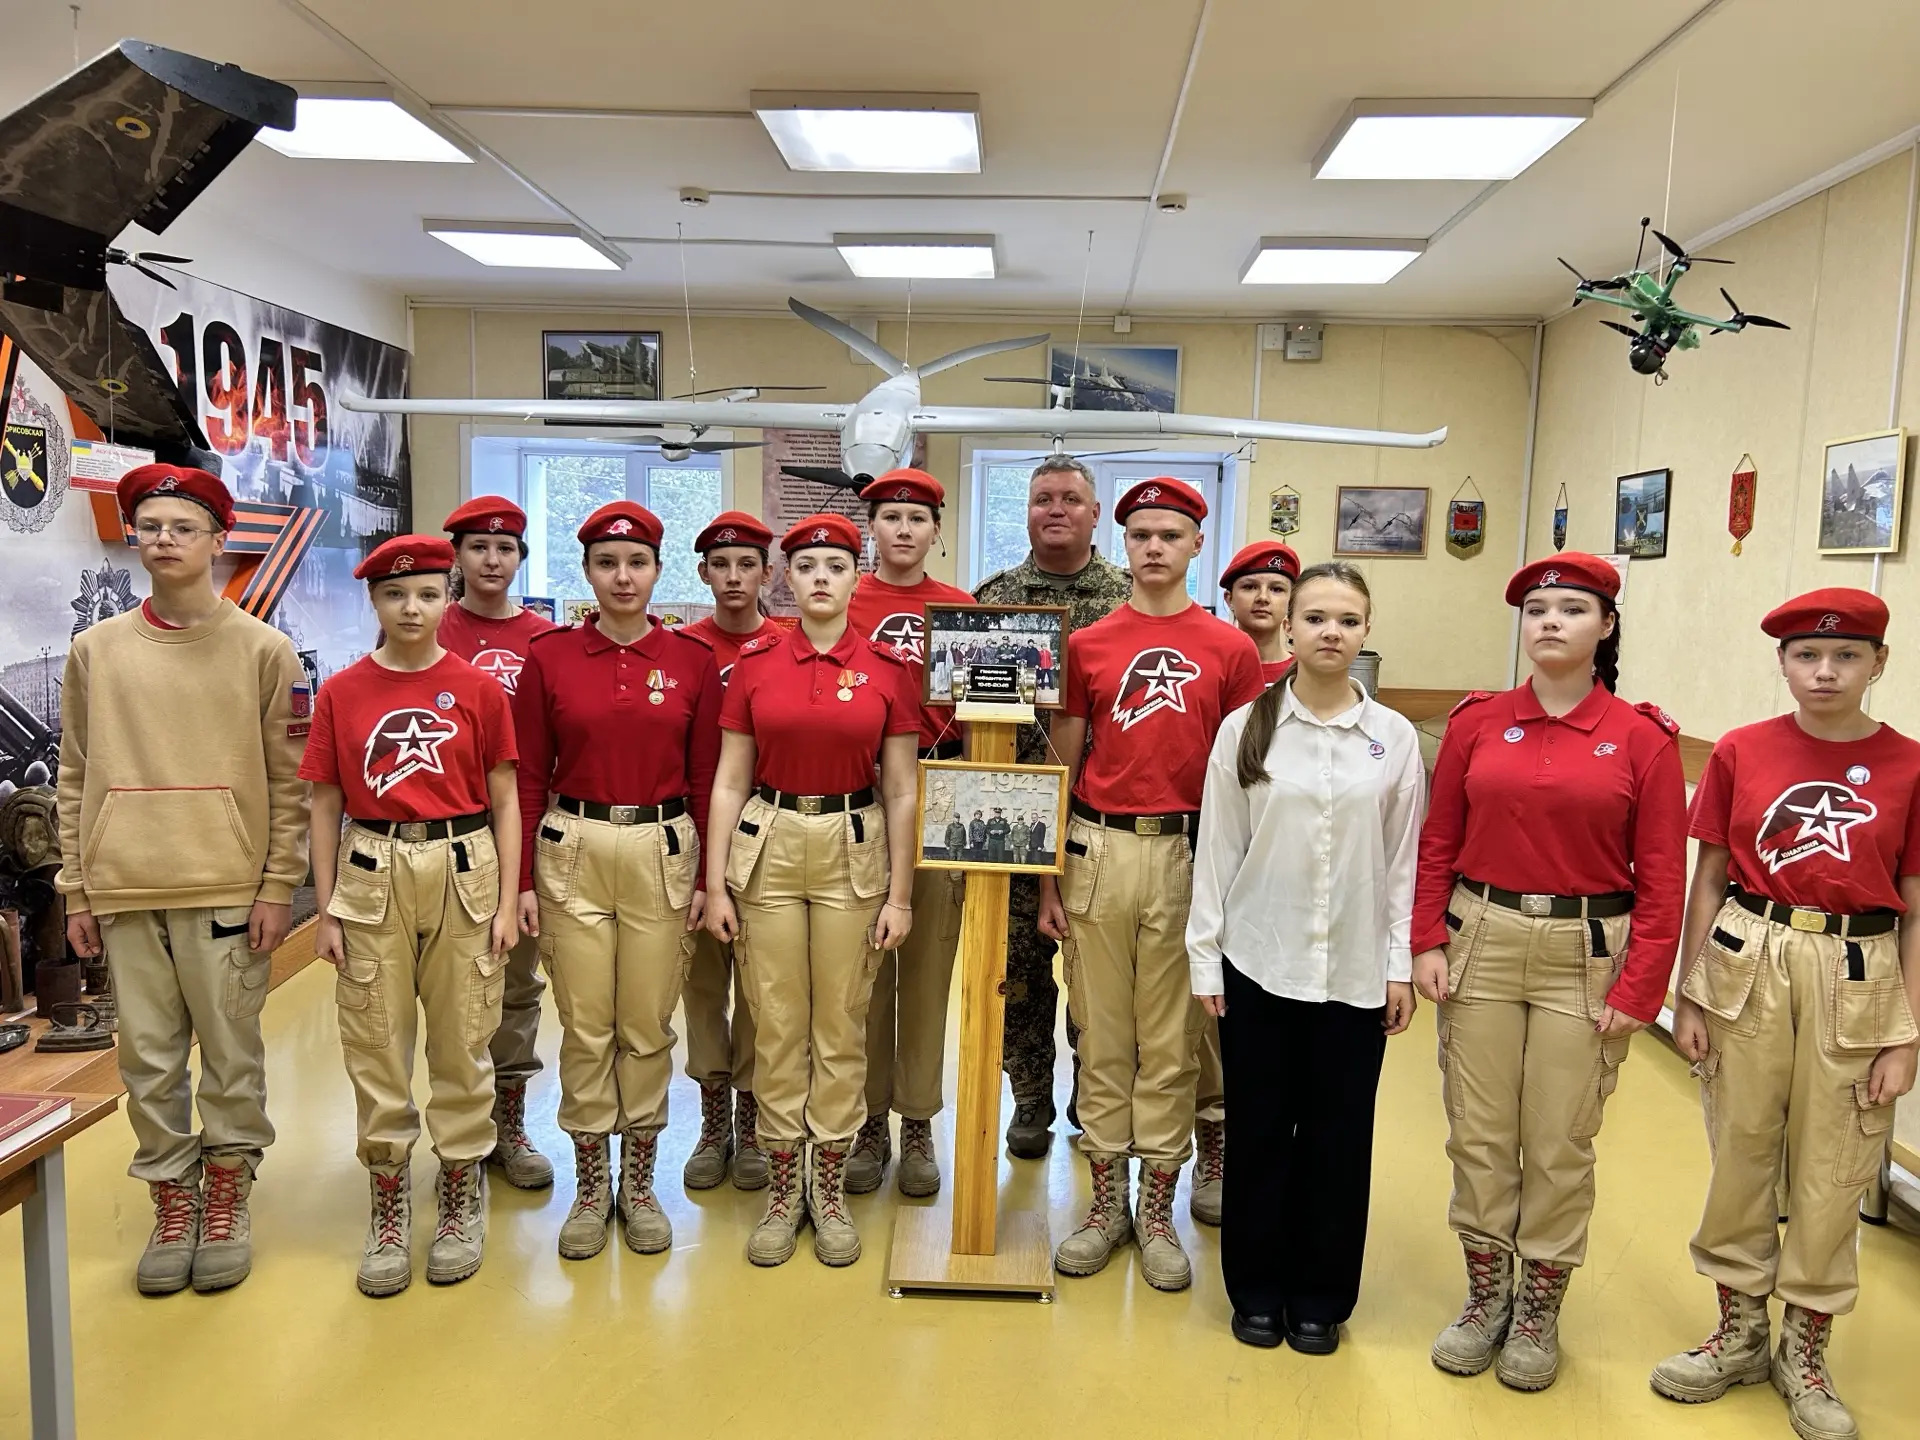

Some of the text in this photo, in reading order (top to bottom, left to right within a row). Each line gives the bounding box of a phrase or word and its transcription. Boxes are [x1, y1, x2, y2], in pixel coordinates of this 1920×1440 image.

[160, 311, 328, 468] 1945
[5, 425, 44, 437] ОРИСОВСКАЯ
[1780, 839, 1820, 859] ЮНАРМИЯ
